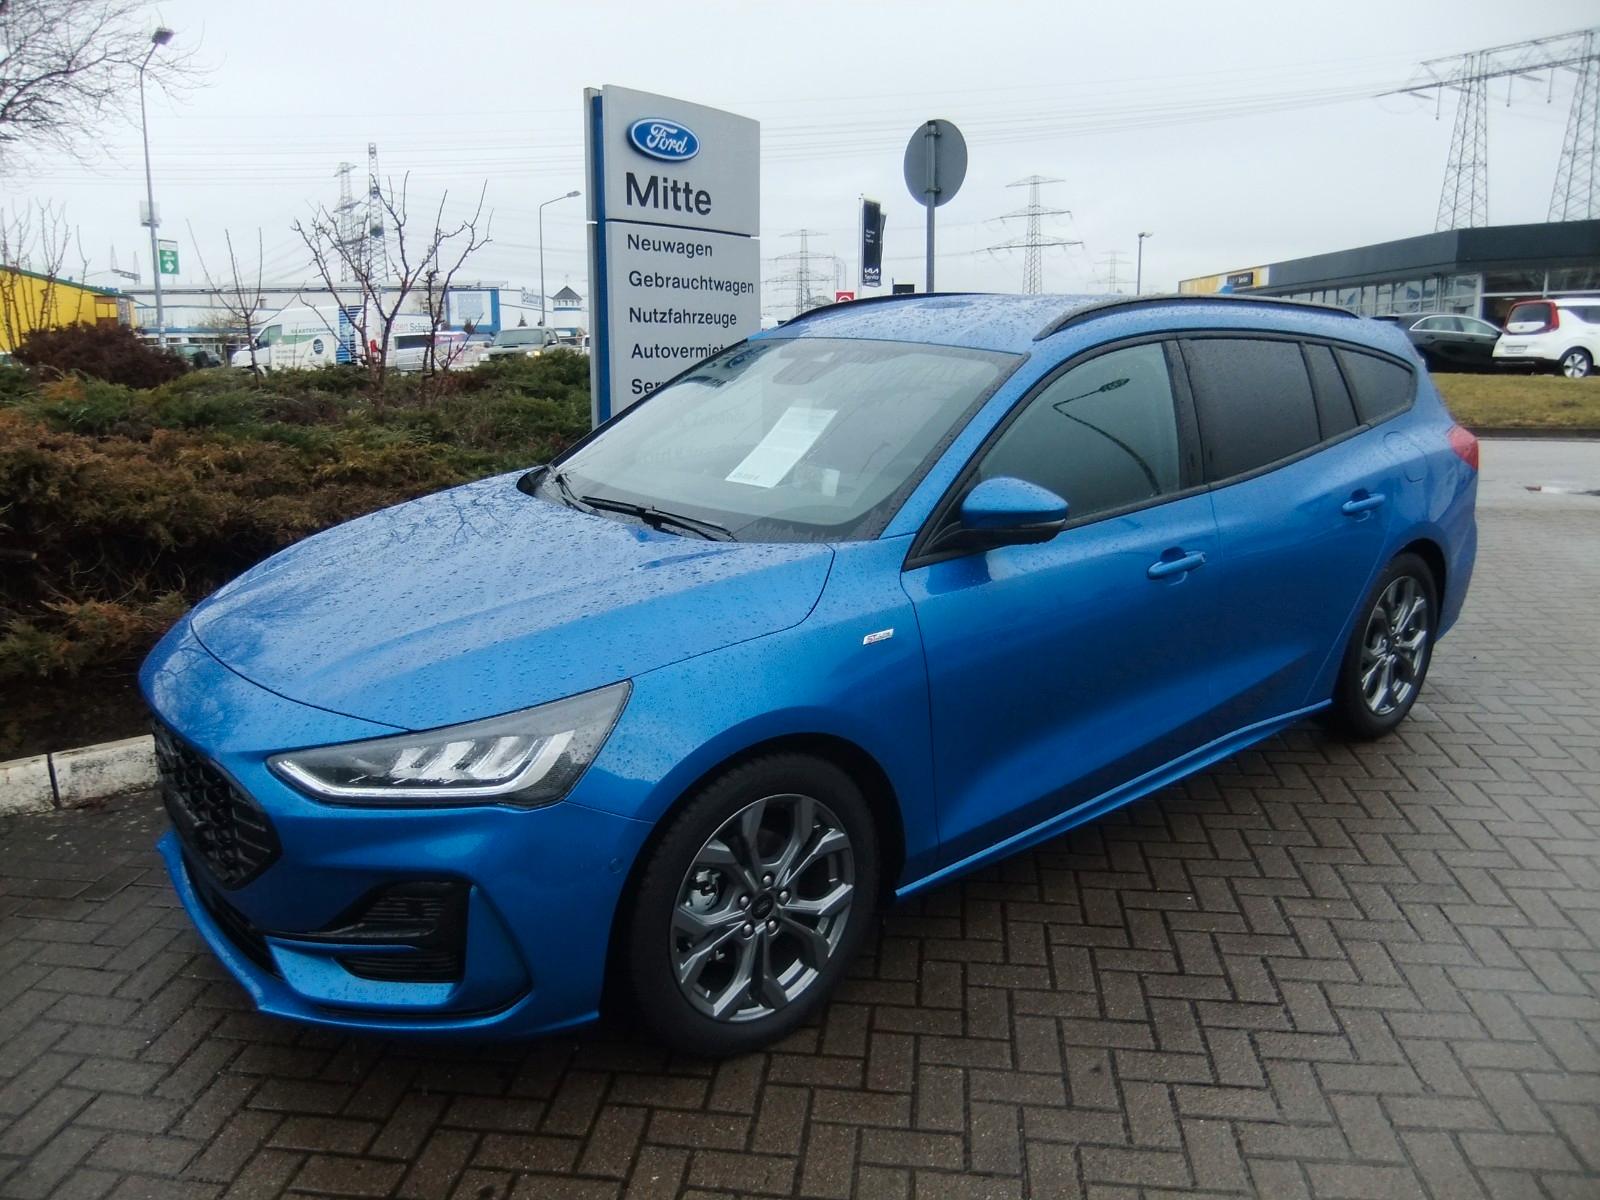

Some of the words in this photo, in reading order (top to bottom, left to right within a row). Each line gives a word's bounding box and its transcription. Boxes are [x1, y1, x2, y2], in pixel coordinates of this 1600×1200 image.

[646, 123, 689, 154] Ford
[625, 171, 712, 216] Mitte
[627, 233, 713, 258] Neuwagen
[628, 270, 754, 296] Gebrauchtwagen
[629, 306, 737, 328] Nutzfahrzeuge
[631, 378, 664, 395] Ser
